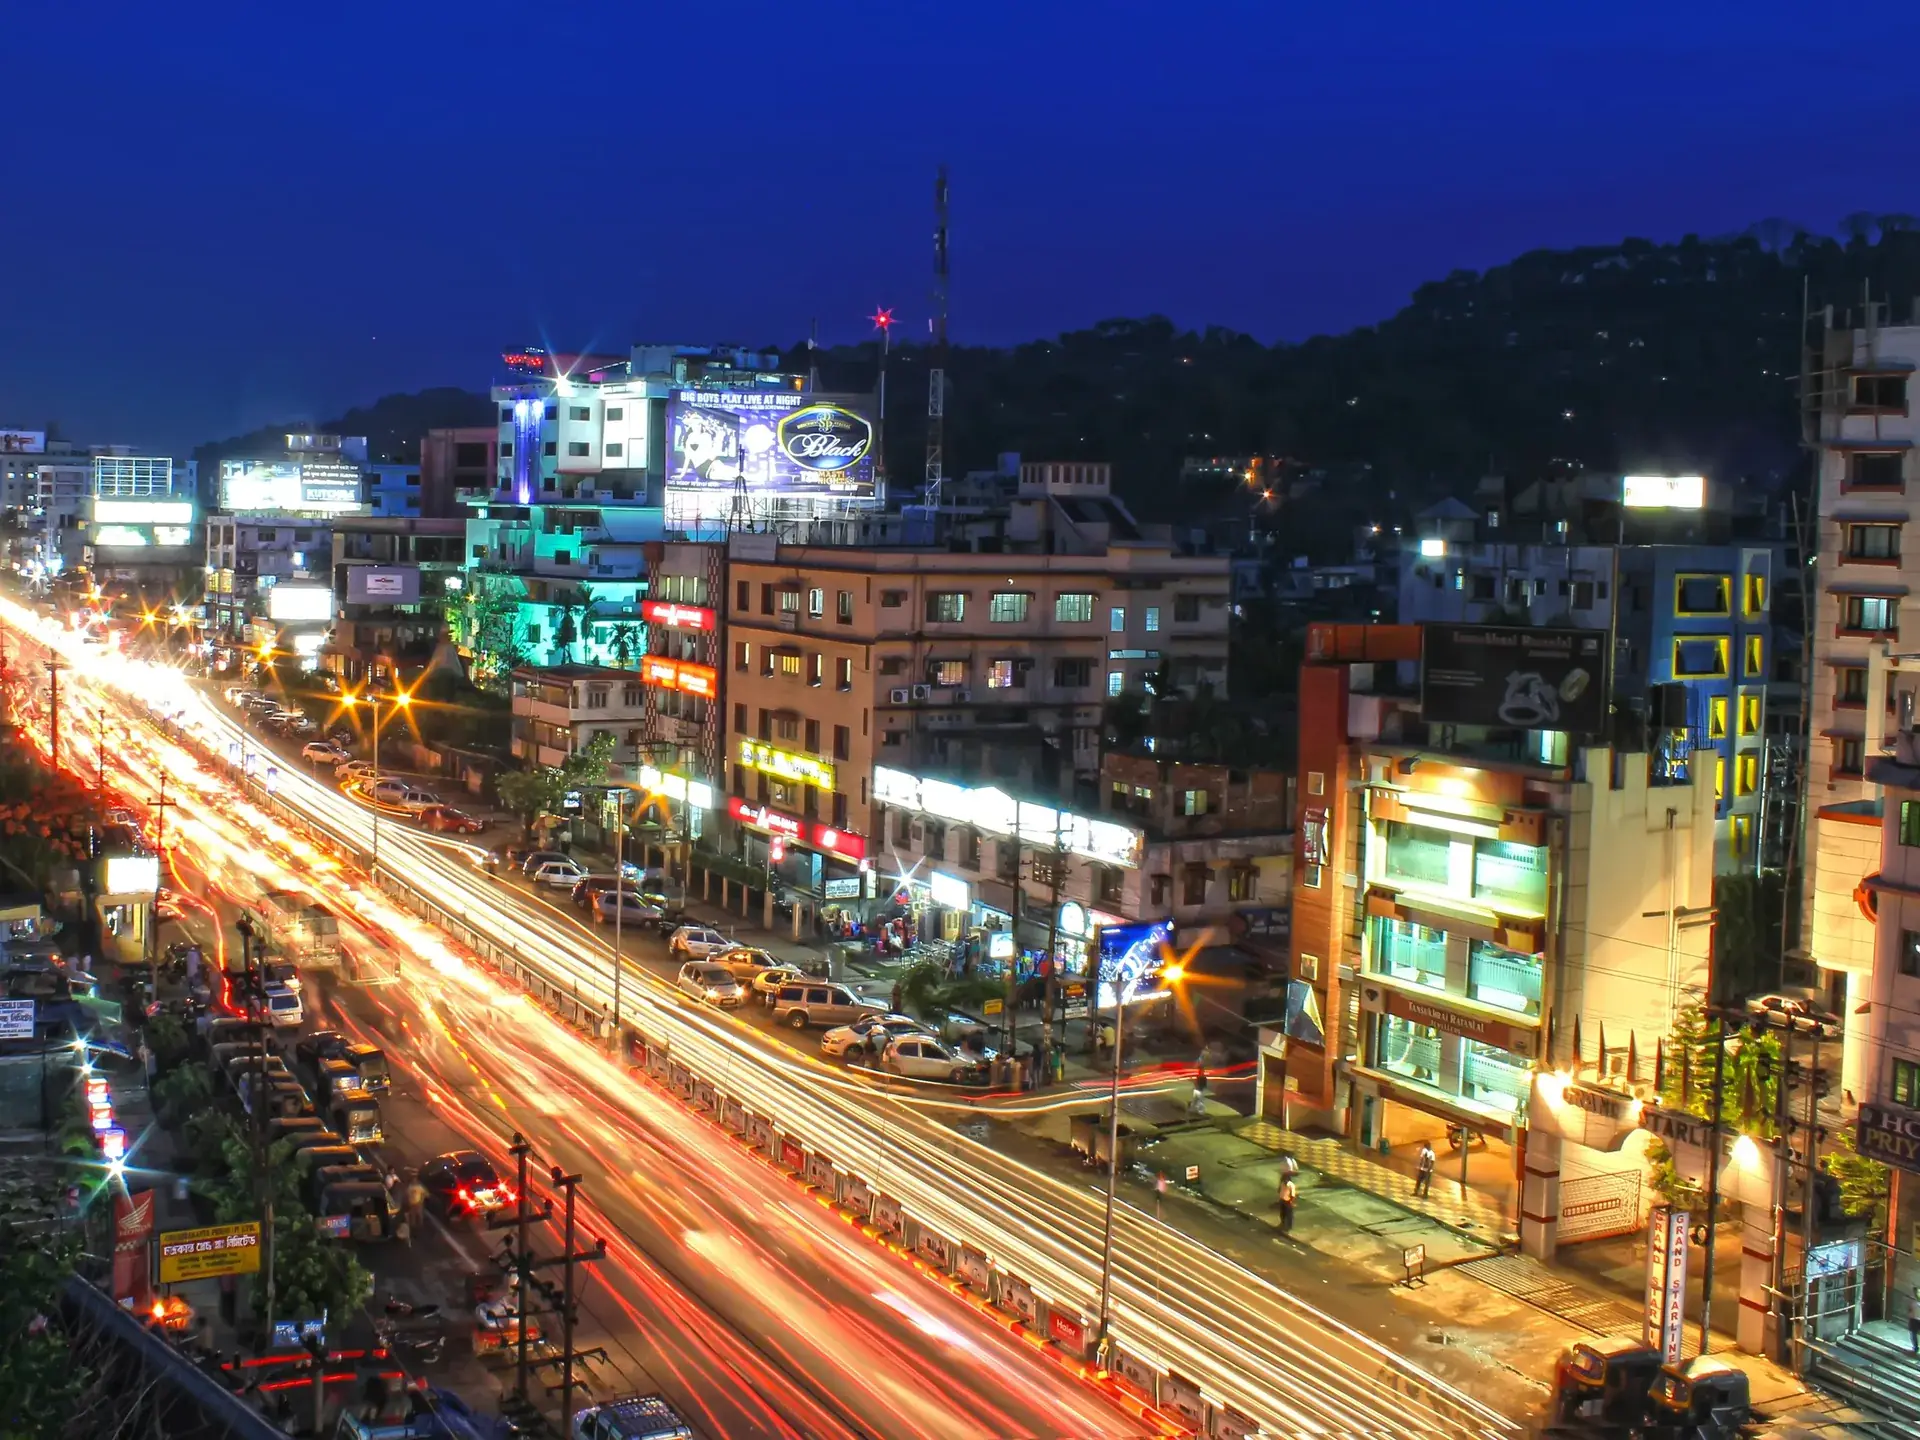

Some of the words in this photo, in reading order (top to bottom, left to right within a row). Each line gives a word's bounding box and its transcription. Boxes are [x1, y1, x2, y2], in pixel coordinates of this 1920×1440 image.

[680, 391, 696, 402] BIG
[697, 392, 720, 403] BOYS
[720, 393, 743, 404] PLAY
[743, 394, 762, 405] LIVE
[763, 395, 775, 405] AT
[776, 395, 802, 406] NIGHT
[788, 433, 866, 457] Black
[119, 1222, 153, 1237] HONDA
[1674, 1214, 1684, 1267] GRAND
[1056, 1318, 1076, 1337] Haier
[1668, 1279, 1681, 1363] STARLINE
